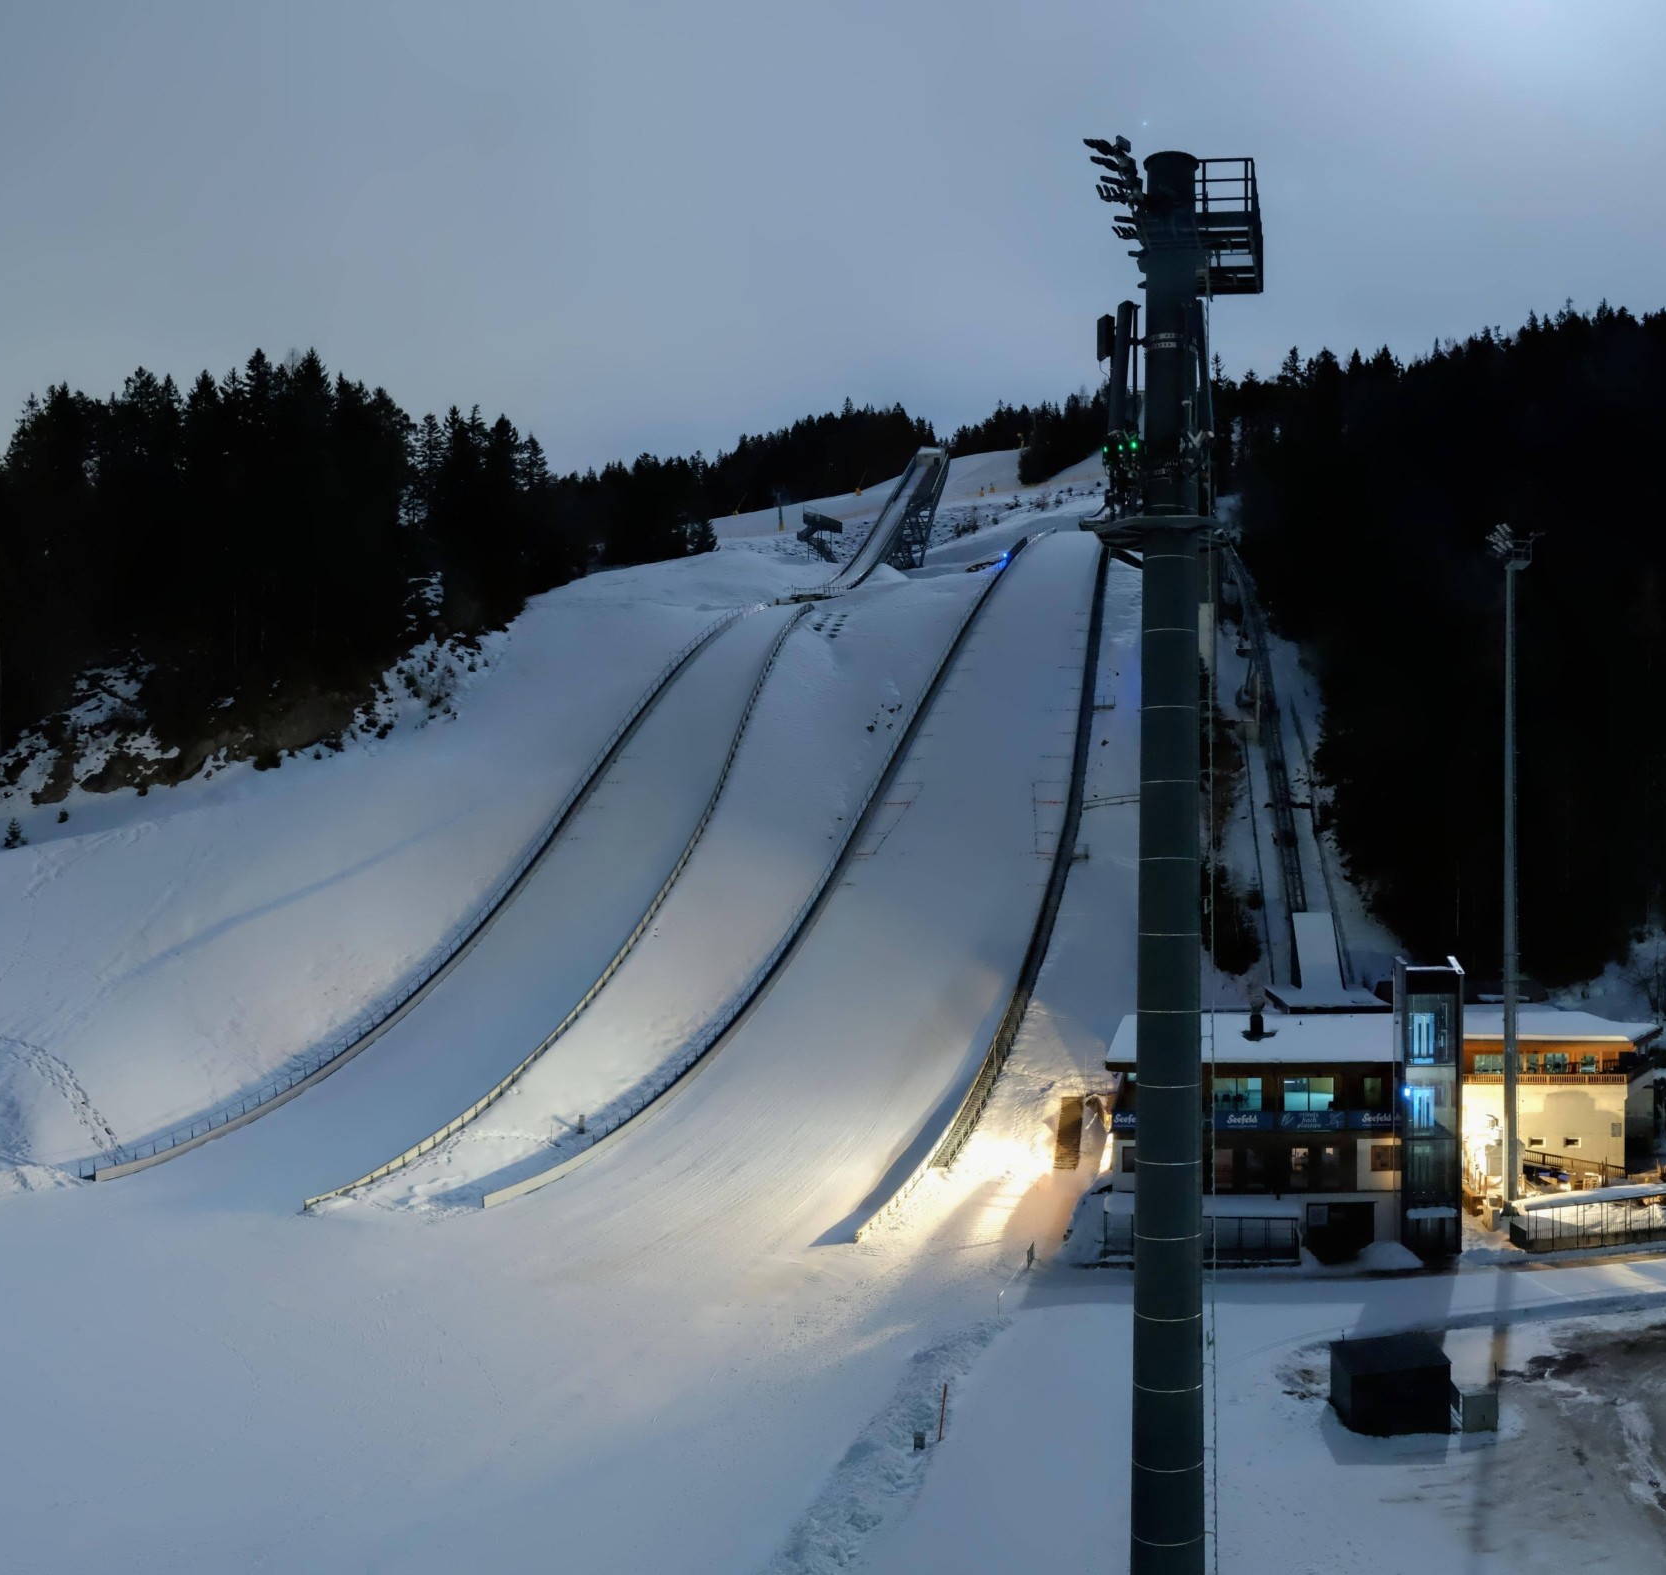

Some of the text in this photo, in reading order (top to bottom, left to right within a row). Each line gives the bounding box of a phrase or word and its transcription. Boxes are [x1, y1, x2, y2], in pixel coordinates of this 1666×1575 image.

[1113, 1113, 1136, 1124] Seefe
[1226, 1113, 1258, 1124] Seefeld
[1361, 1113, 1392, 1123] Seefeld
